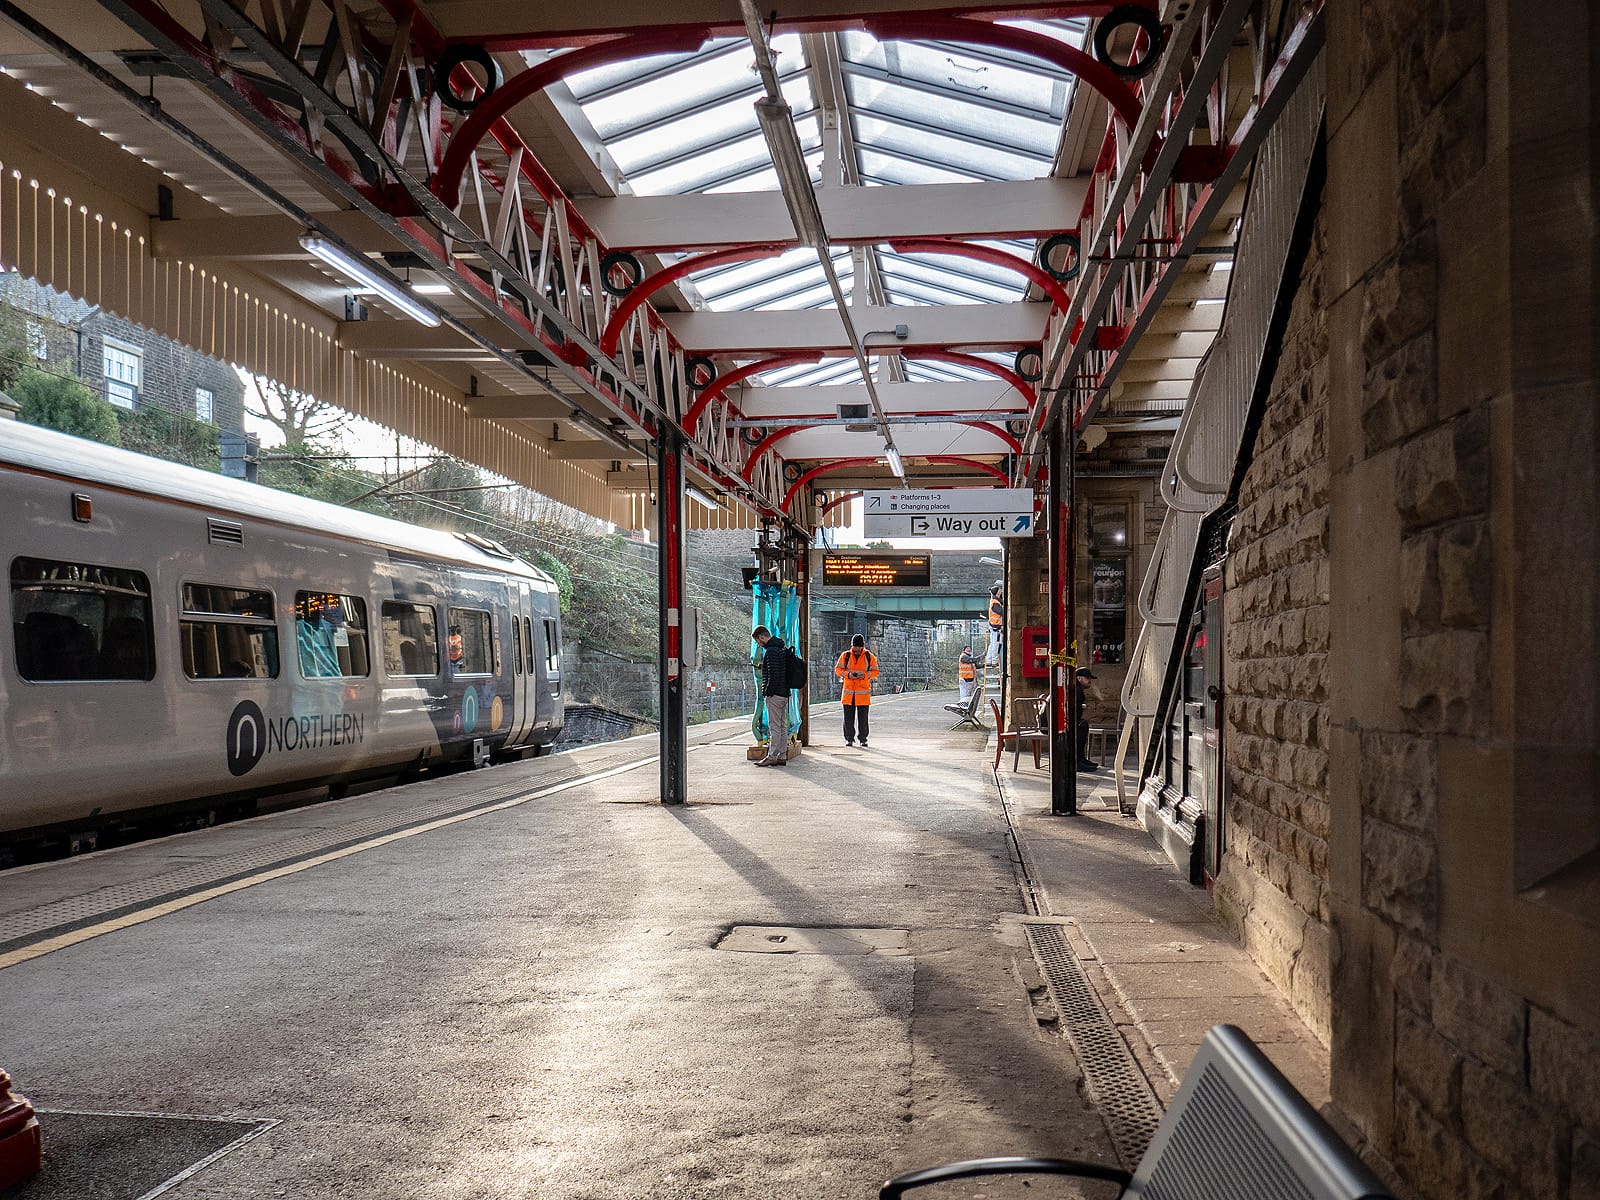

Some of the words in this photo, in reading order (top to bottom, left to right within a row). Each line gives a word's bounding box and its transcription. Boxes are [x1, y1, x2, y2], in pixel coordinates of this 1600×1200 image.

[900, 503, 930, 511] Changing
[930, 503, 951, 511] places
[936, 517, 973, 534] Way
[978, 516, 1007, 532] out
[1094, 569, 1125, 577] reunion
[268, 712, 364, 753] NORTHERN
